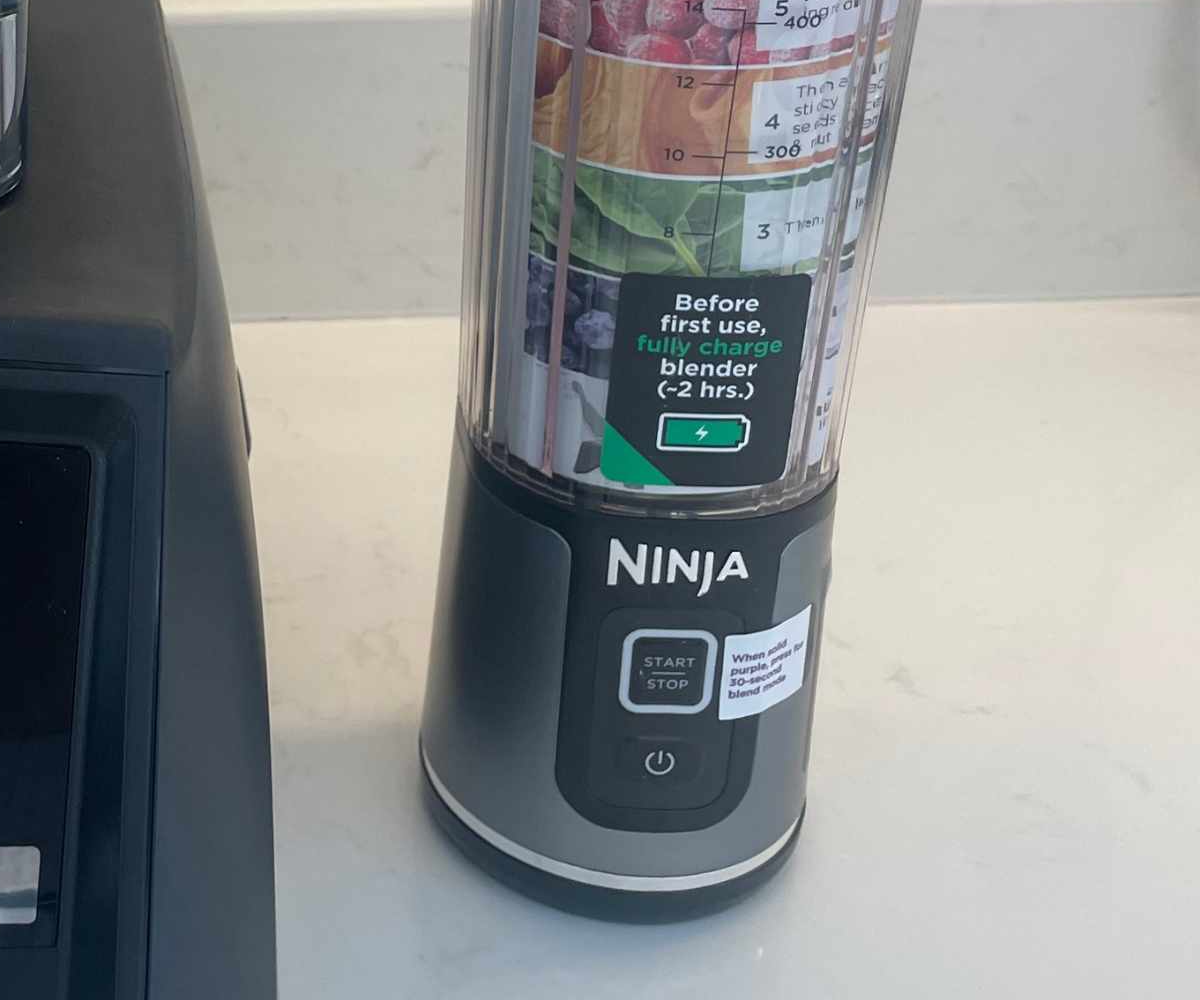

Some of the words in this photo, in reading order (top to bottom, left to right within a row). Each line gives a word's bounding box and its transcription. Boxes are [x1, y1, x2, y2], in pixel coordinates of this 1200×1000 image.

[684, 0, 704, 14] 14
[774, 0, 789, 17] 5
[783, 14, 822, 30] 400
[676, 75, 695, 89] 12
[764, 113, 781, 131] 4
[665, 148, 685, 162] 10
[764, 144, 801, 159] 300
[663, 225, 675, 239] 8
[757, 223, 771, 240] 3
[674, 293, 760, 313] Before
[660, 314, 711, 334] first
[718, 318, 767, 336] use,
[636, 334, 691, 358] fully
[699, 337, 784, 359] charge
[659, 358, 758, 378] blender
[700, 381, 755, 401] hrs.)
[606, 537, 750, 598] NINJA
[644, 656, 697, 669] START
[731, 651, 766, 664] When
[730, 662, 769, 678] purple,
[647, 679, 689, 690] STOP
[727, 685, 761, 700] blend
